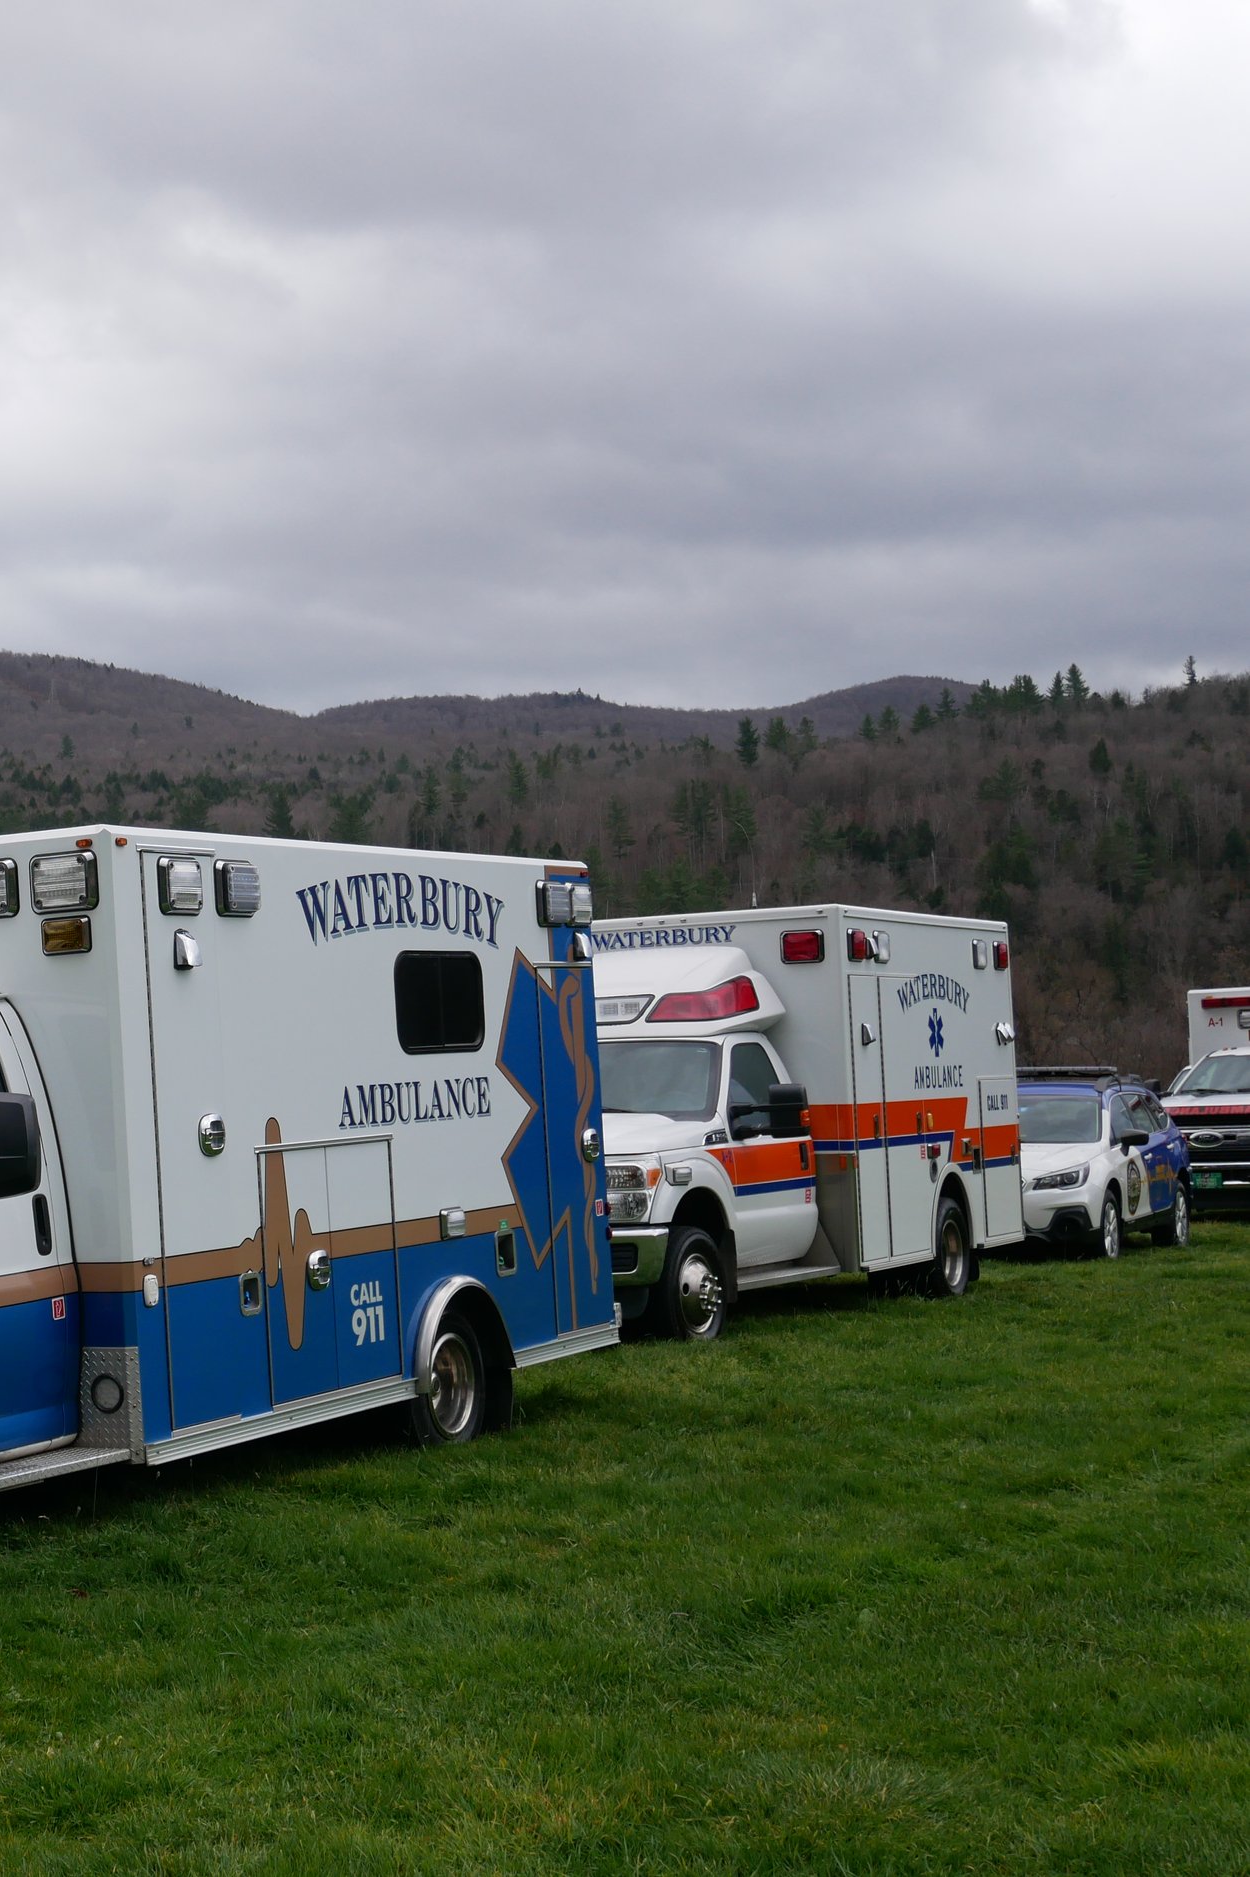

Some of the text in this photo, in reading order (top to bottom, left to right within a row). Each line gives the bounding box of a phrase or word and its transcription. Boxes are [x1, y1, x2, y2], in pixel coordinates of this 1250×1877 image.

[296, 872, 505, 949] WATERBURY
[592, 925, 737, 951] WATERBURY
[897, 973, 970, 1014] WATERBURY
[1208, 1017, 1223, 1027] A-1
[914, 1065, 963, 1089] AMBULANCE
[339, 1077, 491, 1129] AMBULANCE
[987, 1094, 1008, 1111] CALL 911
[350, 1280, 383, 1306] CALL
[352, 1305, 385, 1346] 911
